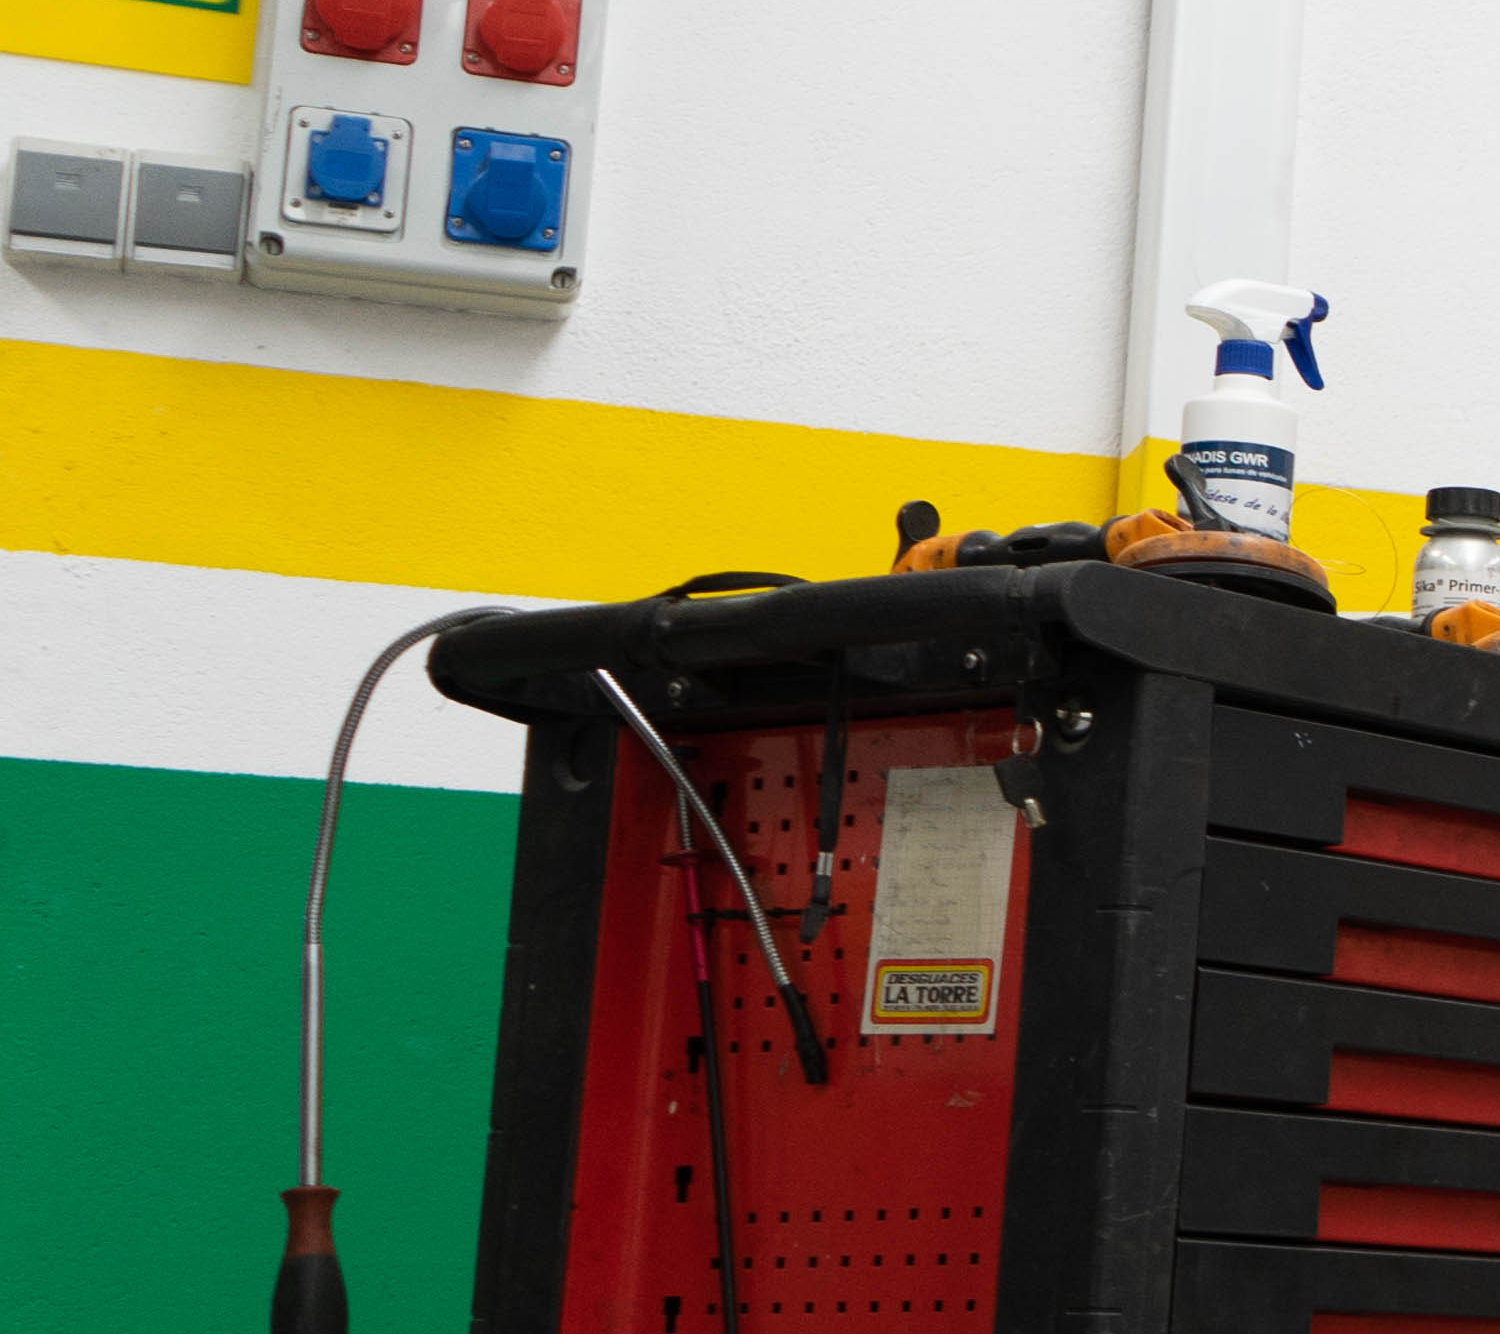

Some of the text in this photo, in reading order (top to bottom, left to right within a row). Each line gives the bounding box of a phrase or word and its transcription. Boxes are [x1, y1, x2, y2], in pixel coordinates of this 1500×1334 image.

[1230, 451, 1268, 467] GWR
[1244, 498, 1261, 510] de
[888, 972, 978, 984] DESGUACES
[884, 986, 978, 1003] LA TORRE
